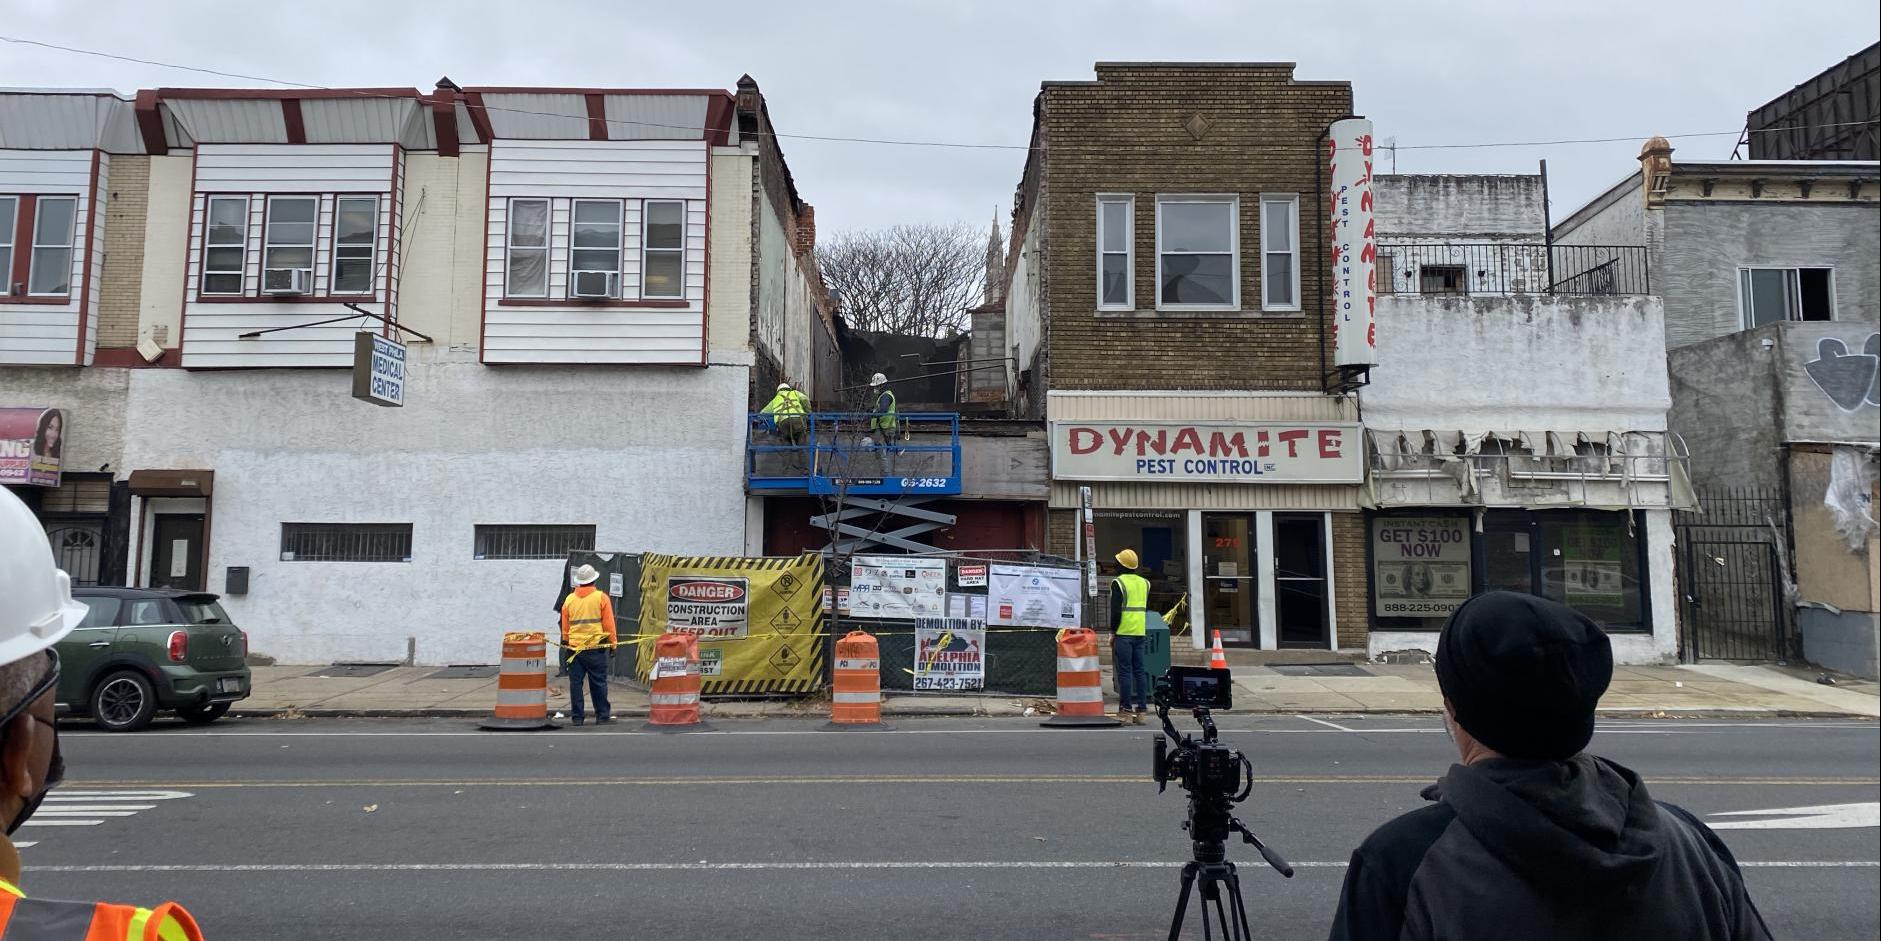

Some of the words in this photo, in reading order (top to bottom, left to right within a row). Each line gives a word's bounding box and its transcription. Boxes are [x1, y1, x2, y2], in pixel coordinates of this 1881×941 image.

[1341, 186, 1349, 227] PEST
[1342, 243, 1351, 321] CONTROL
[374, 340, 388, 354] WEST
[373, 354, 403, 380] MEDICAL
[373, 376, 400, 400] CENTER
[1068, 427, 1342, 458] DYNAMITE
[1136, 459, 1175, 474] PEST
[1184, 459, 1263, 475] CONTROL
[1093, 511, 1180, 519] namitepestcontrol.com
[1380, 529, 1413, 543] GET
[1418, 529, 1462, 543] $100
[1401, 543, 1441, 557] NOW
[679, 586, 735, 598] DANGER
[668, 603, 745, 616] CONSTRUCTION
[1384, 603, 1456, 612] 888-225-090
[690, 617, 718, 626] AREA
[916, 617, 967, 629] DEMOLITION
[970, 619, 986, 630] BY:
[709, 627, 738, 636] OUT
[919, 651, 981, 662] ADELPHIA
[918, 662, 981, 671] DEMOLITION
[915, 677, 982, 688] 267-423-7521
